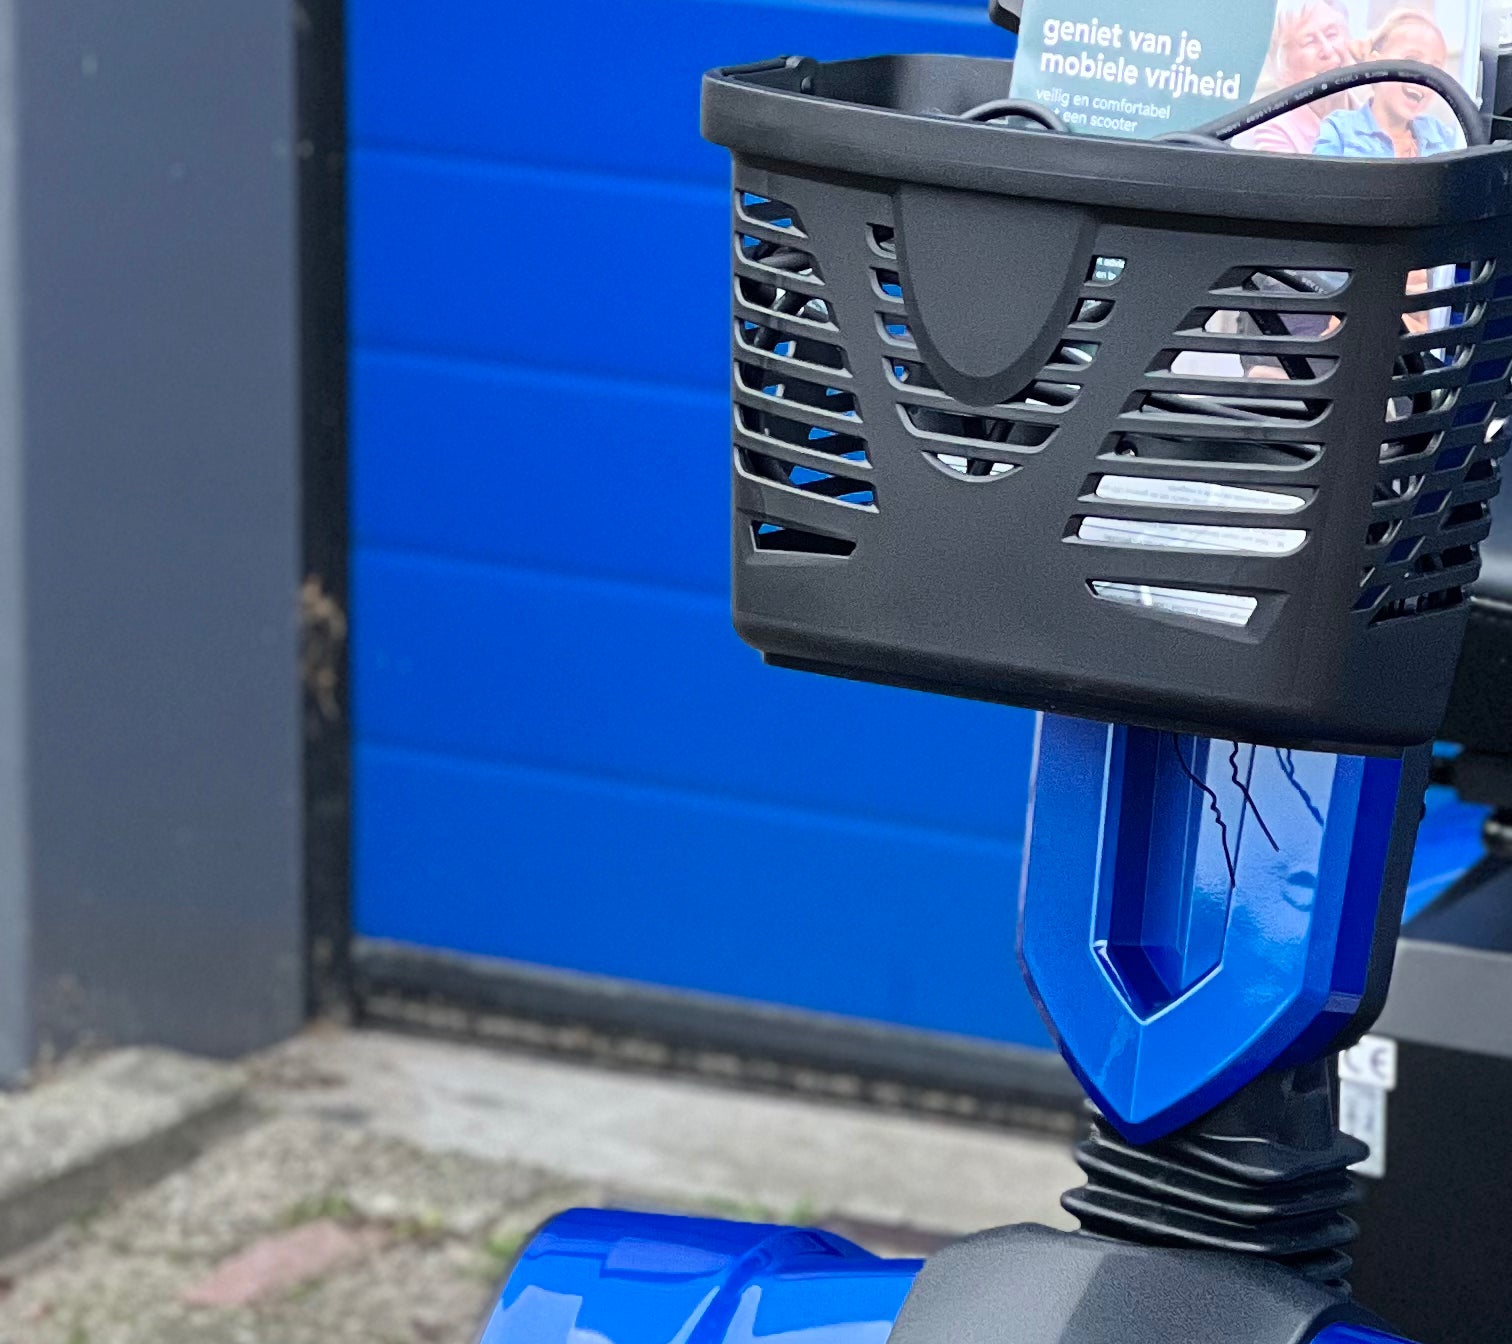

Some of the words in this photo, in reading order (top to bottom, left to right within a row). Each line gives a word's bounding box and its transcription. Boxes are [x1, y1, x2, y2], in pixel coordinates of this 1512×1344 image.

[1042, 17, 1123, 48] geniet
[1129, 30, 1172, 55] van
[1175, 30, 1202, 63] je
[1040, 51, 1139, 85] mobiele
[1145, 63, 1241, 100] vrijheid
[1036, 87, 1070, 107] veilig
[1073, 93, 1089, 107] en
[1092, 97, 1171, 120] comfortabel
[1062, 111, 1087, 125] een
[1090, 113, 1138, 132] scooter
